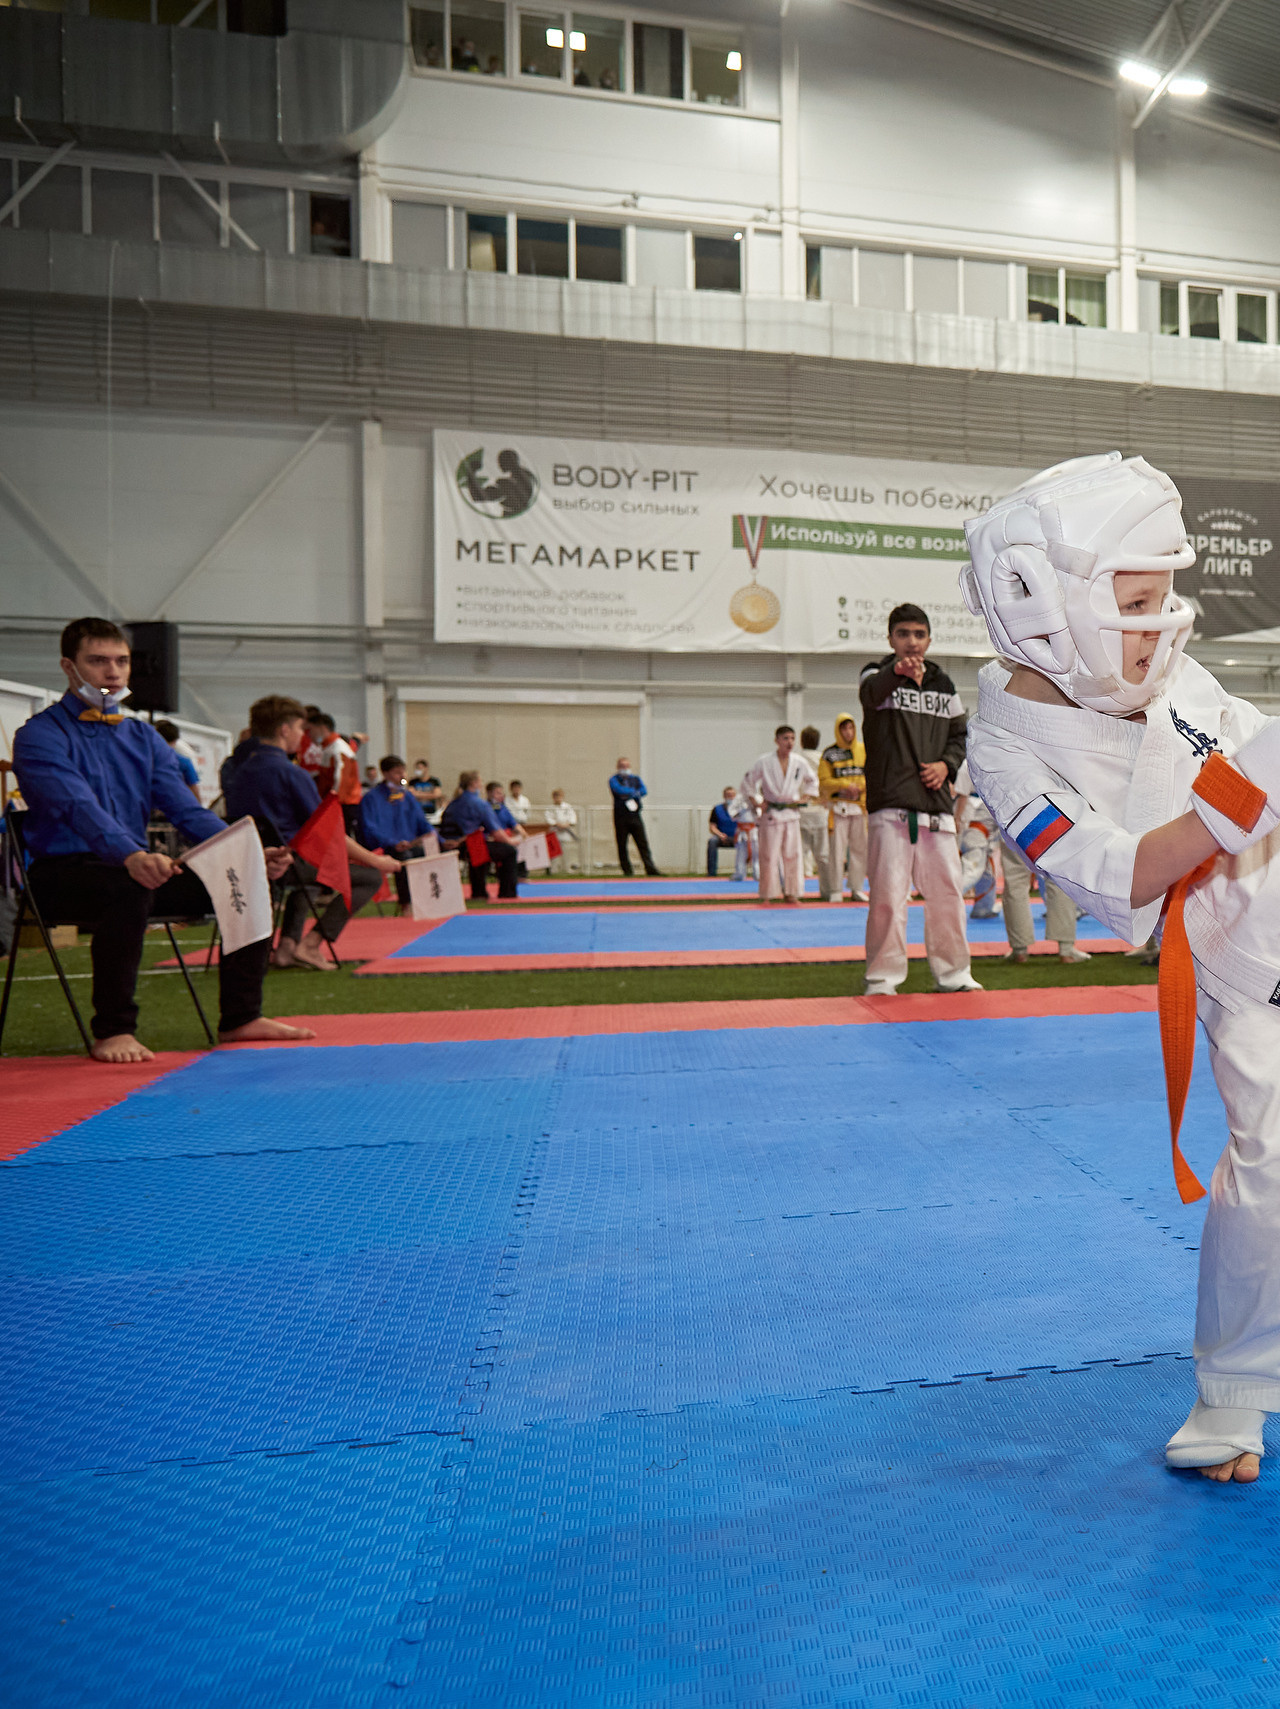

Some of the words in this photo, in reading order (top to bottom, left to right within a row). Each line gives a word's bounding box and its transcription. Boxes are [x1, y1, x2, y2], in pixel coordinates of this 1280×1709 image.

[552, 463, 699, 492] BODY-PIT
[552, 498, 615, 514] выбор
[620, 501, 700, 517] сильных
[759, 474, 875, 505] Хочешь
[885, 486, 999, 513] побежд
[771, 523, 877, 551] Используй
[882, 534, 917, 550] все
[1186, 533, 1273, 557] ПРЕМЬЕР
[456, 539, 700, 572] МЕГАМАРКЕТ
[1202, 556, 1253, 577] ЛИГА
